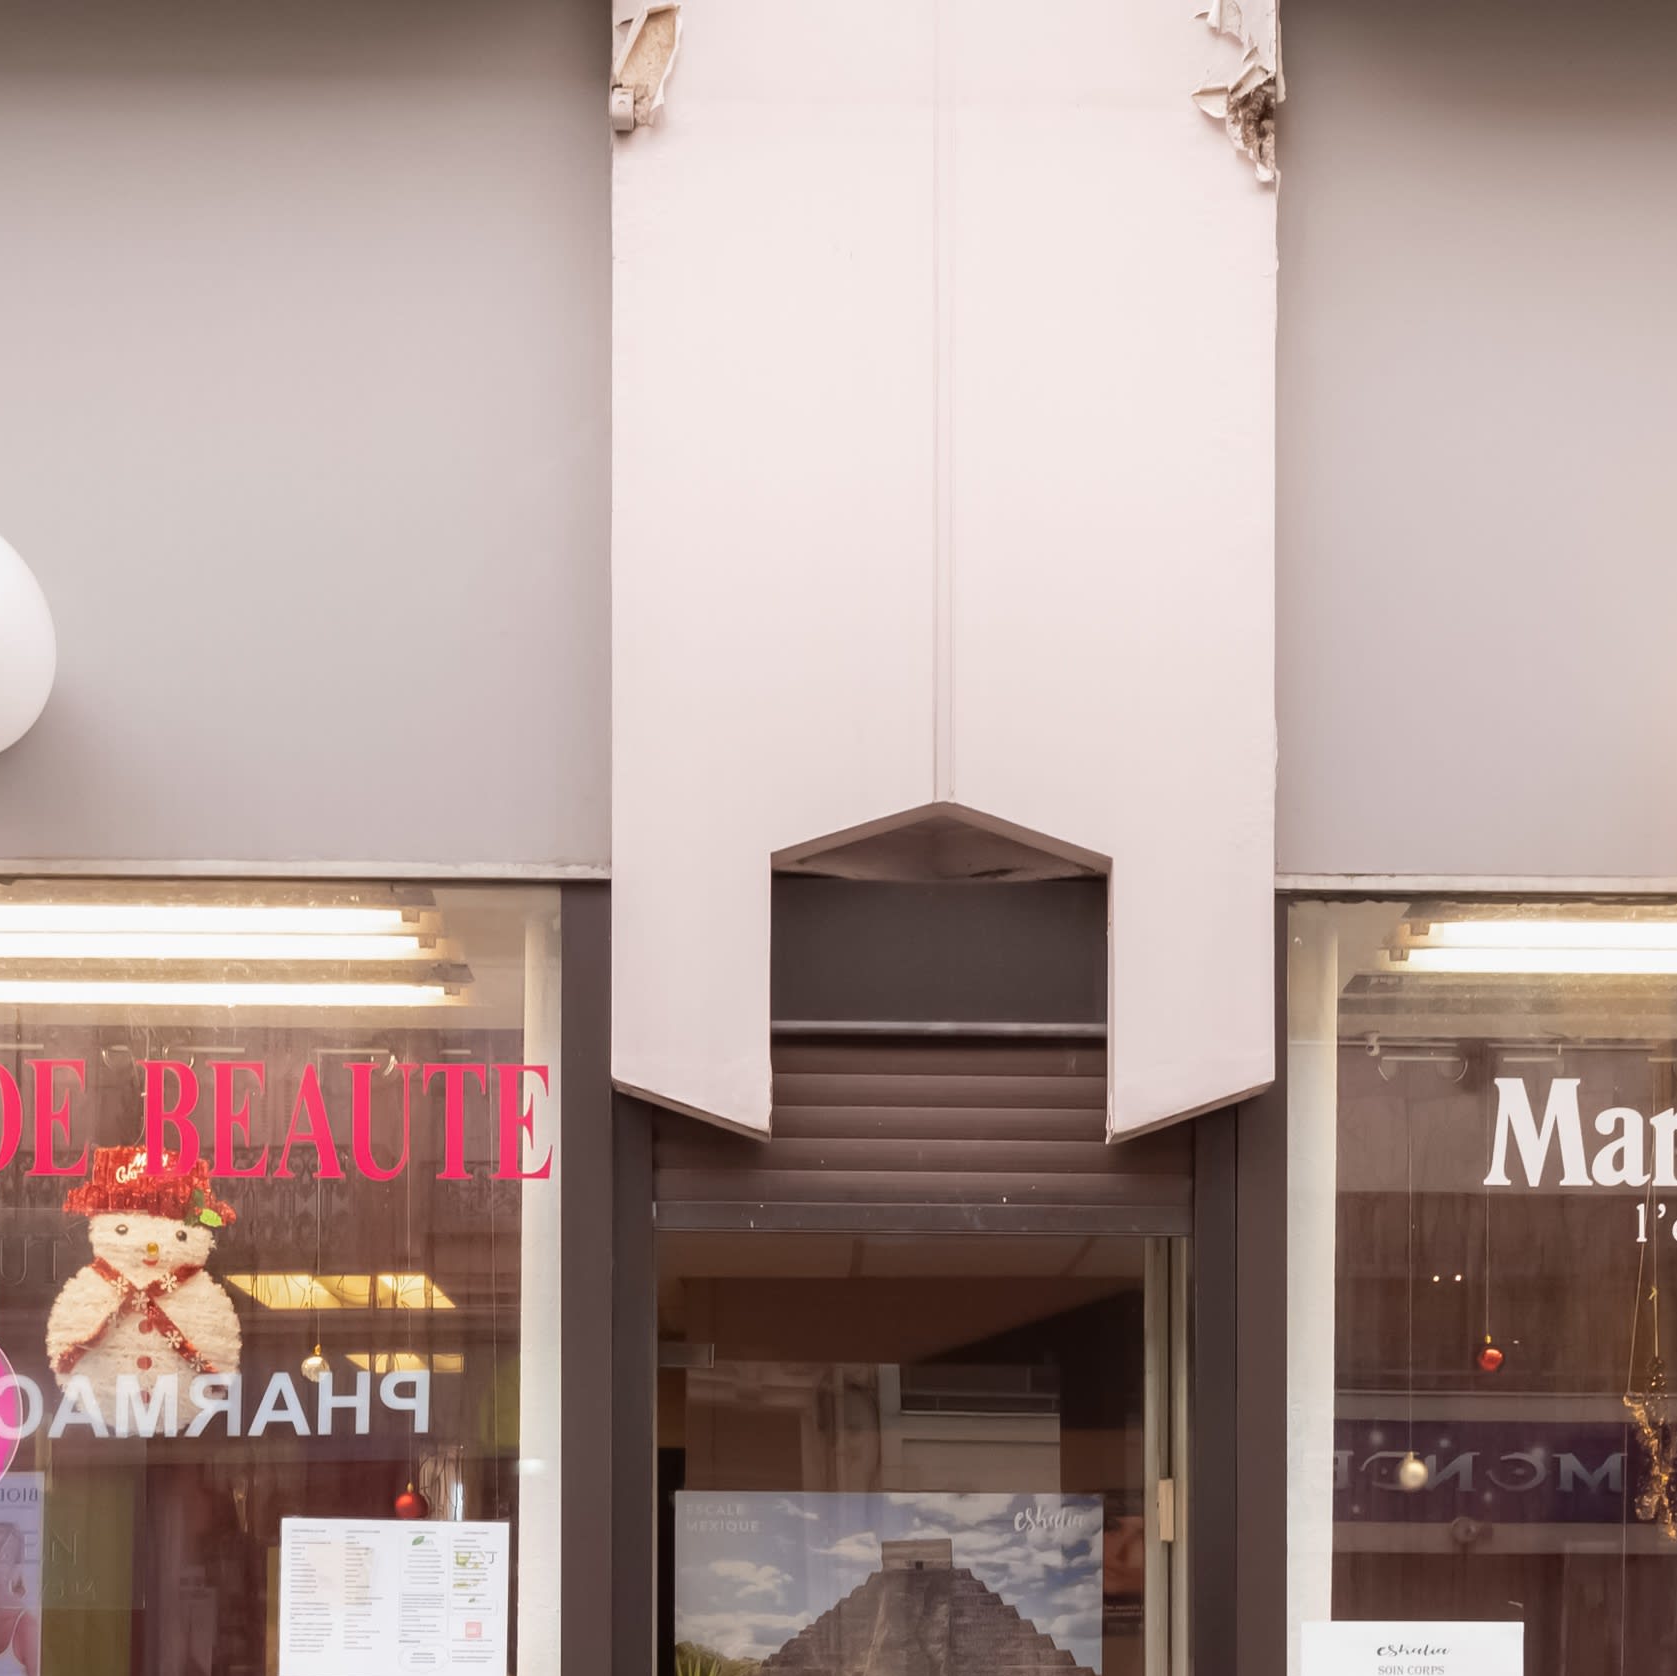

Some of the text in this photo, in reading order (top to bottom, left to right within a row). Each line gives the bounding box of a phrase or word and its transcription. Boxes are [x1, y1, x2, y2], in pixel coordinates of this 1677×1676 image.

[137, 1061, 554, 1182] BEAUTE
[1378, 1665, 1445, 1676] SOIN CORPS
